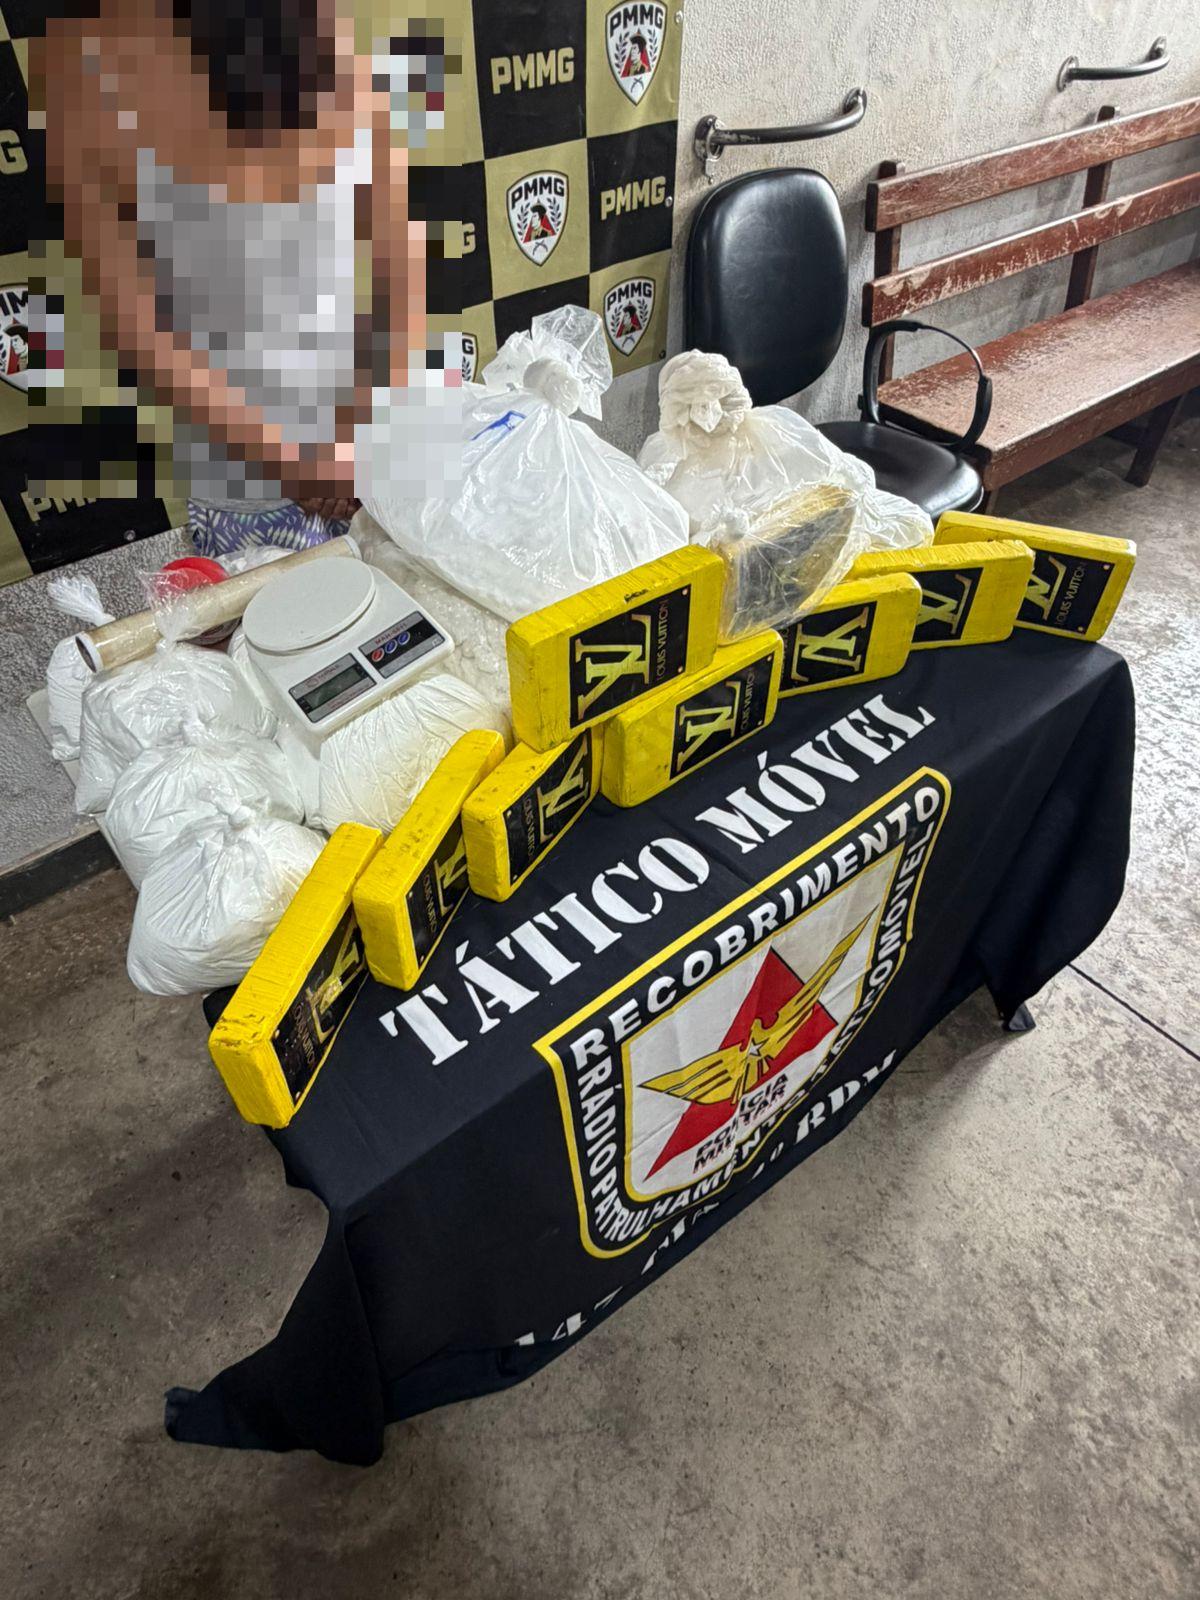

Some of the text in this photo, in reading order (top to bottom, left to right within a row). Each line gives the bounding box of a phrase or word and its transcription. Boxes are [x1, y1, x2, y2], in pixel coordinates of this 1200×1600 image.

[610, 3, 664, 38] PMMG
[490, 47, 575, 95] PMMG
[511, 176, 566, 210] PMMG
[600, 175, 667, 221] PMMG
[605, 281, 653, 308] PMMG
[379, 693, 936, 1066] TÁTICO MÓVEL
[878, 821, 935, 961] MÓVEL
[569, 787, 941, 1071] RECOBRIMENTO
[692, 1085, 786, 1174] MILTAR
